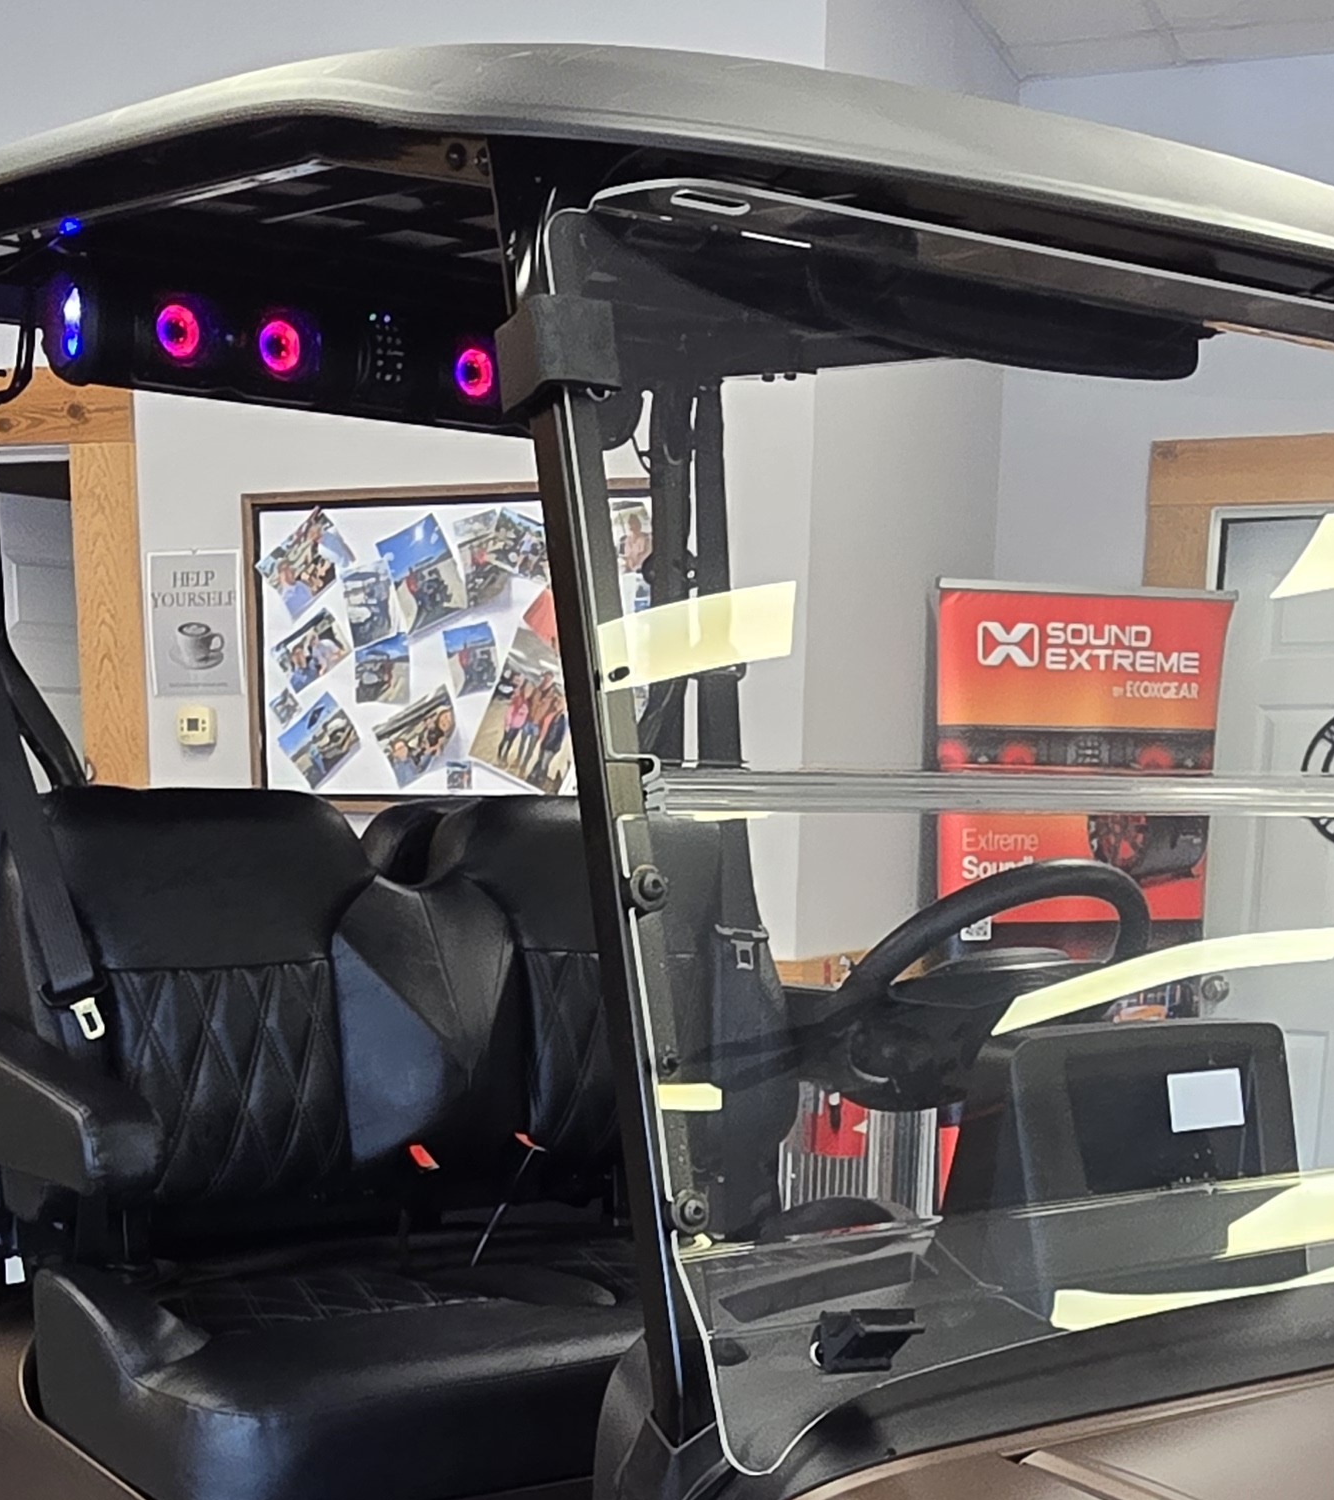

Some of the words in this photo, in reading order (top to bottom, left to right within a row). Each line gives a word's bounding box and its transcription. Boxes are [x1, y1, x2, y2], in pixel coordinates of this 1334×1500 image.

[172, 570, 215, 588] HELP
[150, 590, 237, 609] YOURSELF
[1045, 622, 1152, 648] SOUND
[1044, 647, 1200, 674] EXTREME
[1126, 680, 1199, 699] ECOXGEAR
[961, 828, 1039, 852] Extreme
